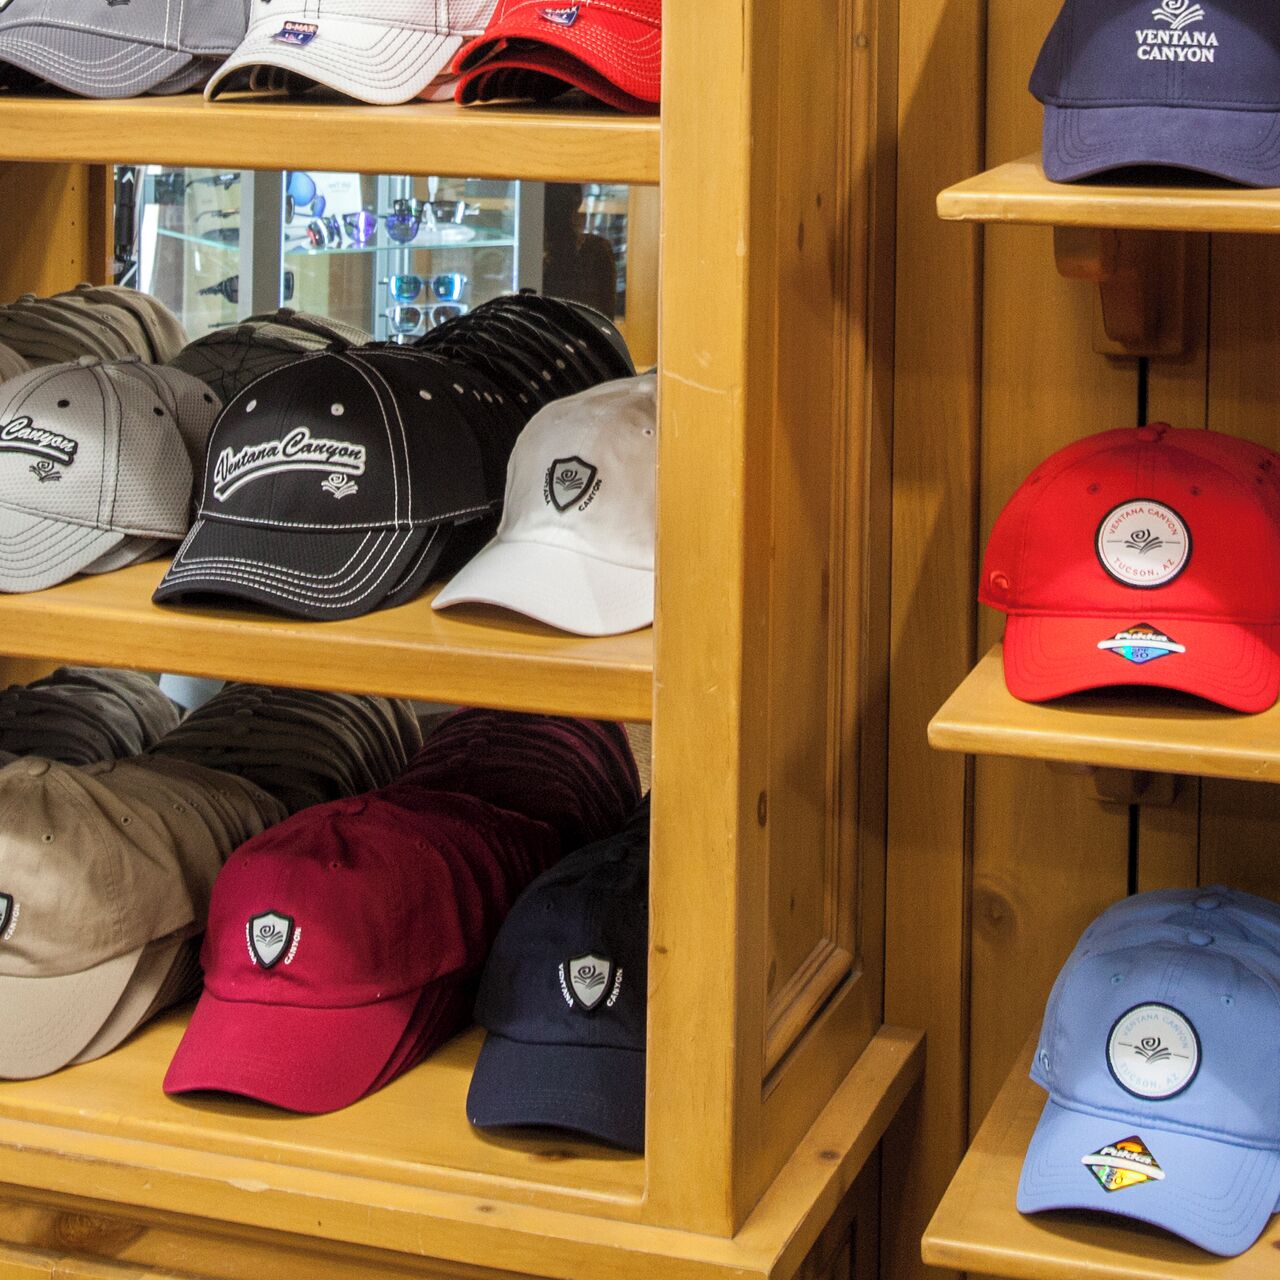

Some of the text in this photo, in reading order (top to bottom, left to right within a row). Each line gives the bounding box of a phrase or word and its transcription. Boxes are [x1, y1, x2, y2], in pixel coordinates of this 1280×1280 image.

[1135, 30, 1219, 47] VENTANA
[1137, 45, 1215, 62] CANYON
[0, 417, 77, 452] Canyon
[215, 429, 364, 483] Ventana Canyon
[1109, 507, 1179, 536] VENTANA CANYON
[1162, 558, 1175, 571] AZ
